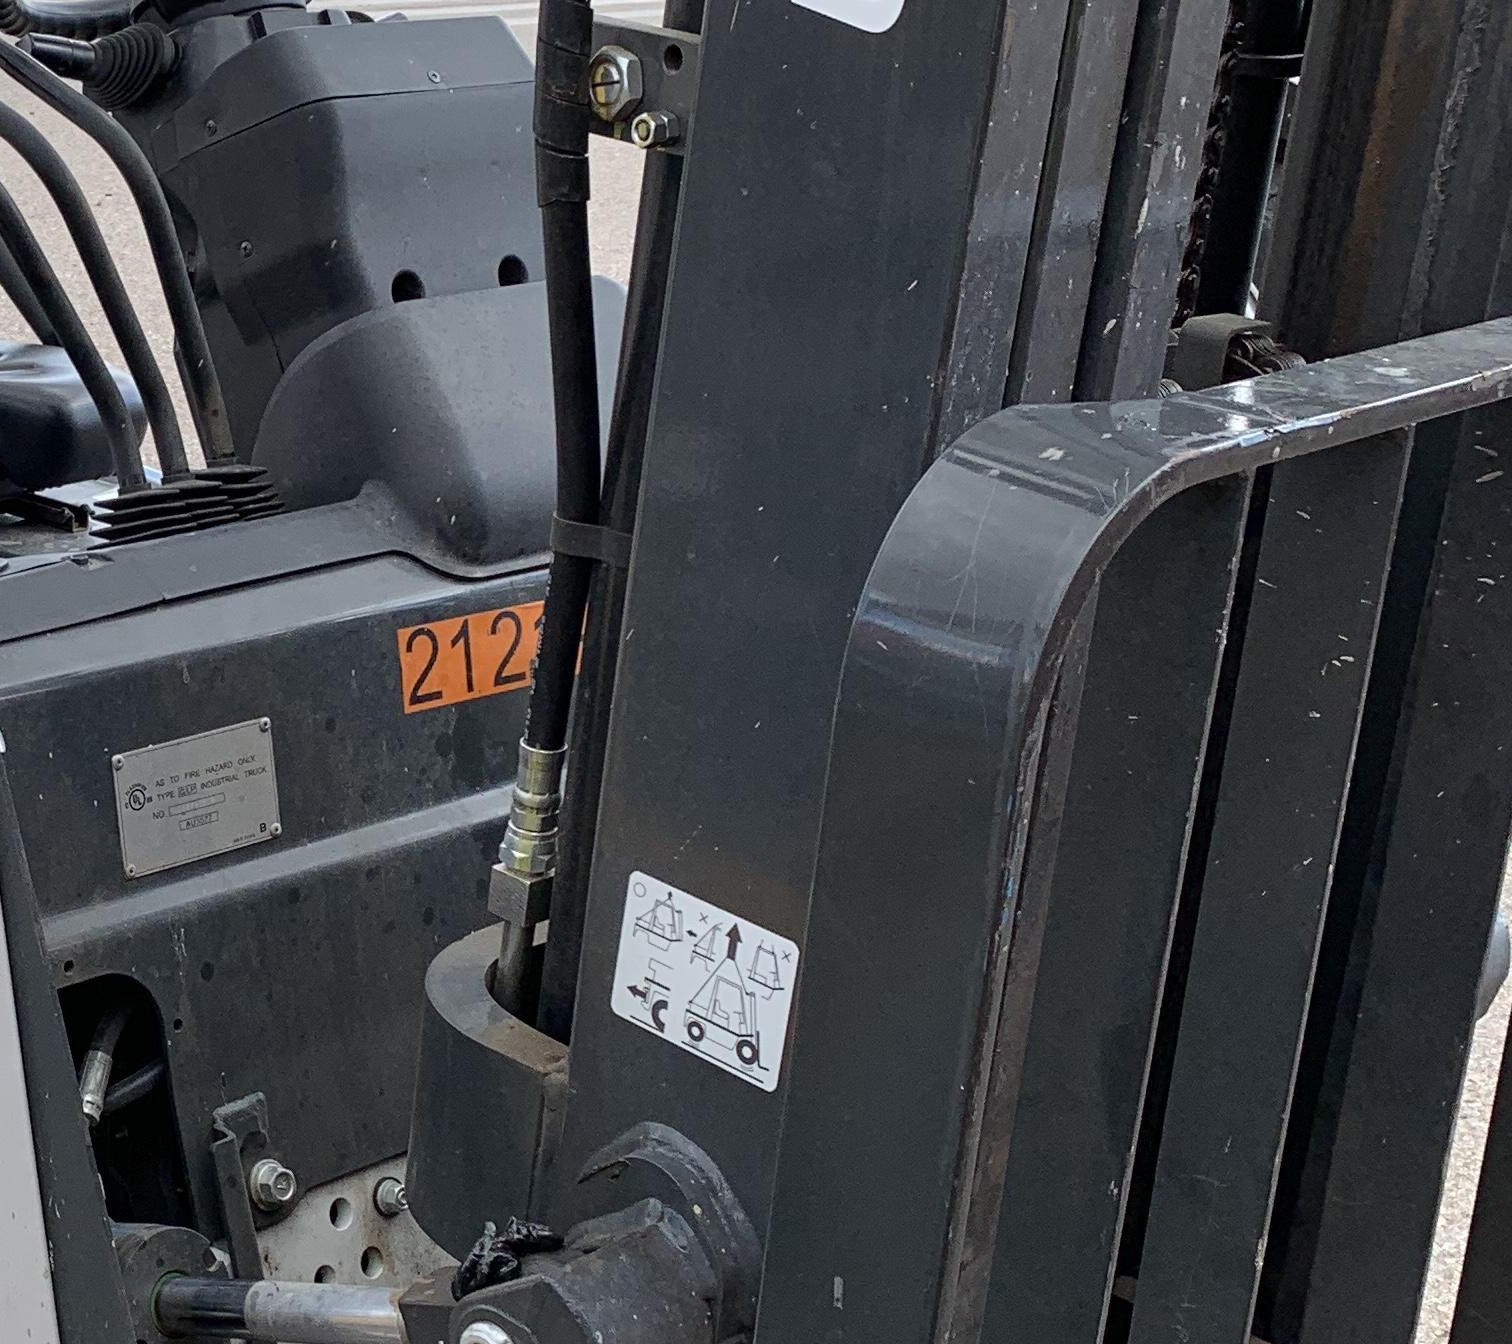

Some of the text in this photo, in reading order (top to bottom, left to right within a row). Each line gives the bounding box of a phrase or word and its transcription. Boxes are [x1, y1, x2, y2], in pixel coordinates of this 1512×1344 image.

[155, 754, 256, 788] AS TO FIRE HAZARD ONLY
[157, 790, 176, 801] TYPE
[200, 775, 239, 790] INDUSTRIAL
[244, 767, 267, 779] TRUCK
[259, 822, 267, 833] B
